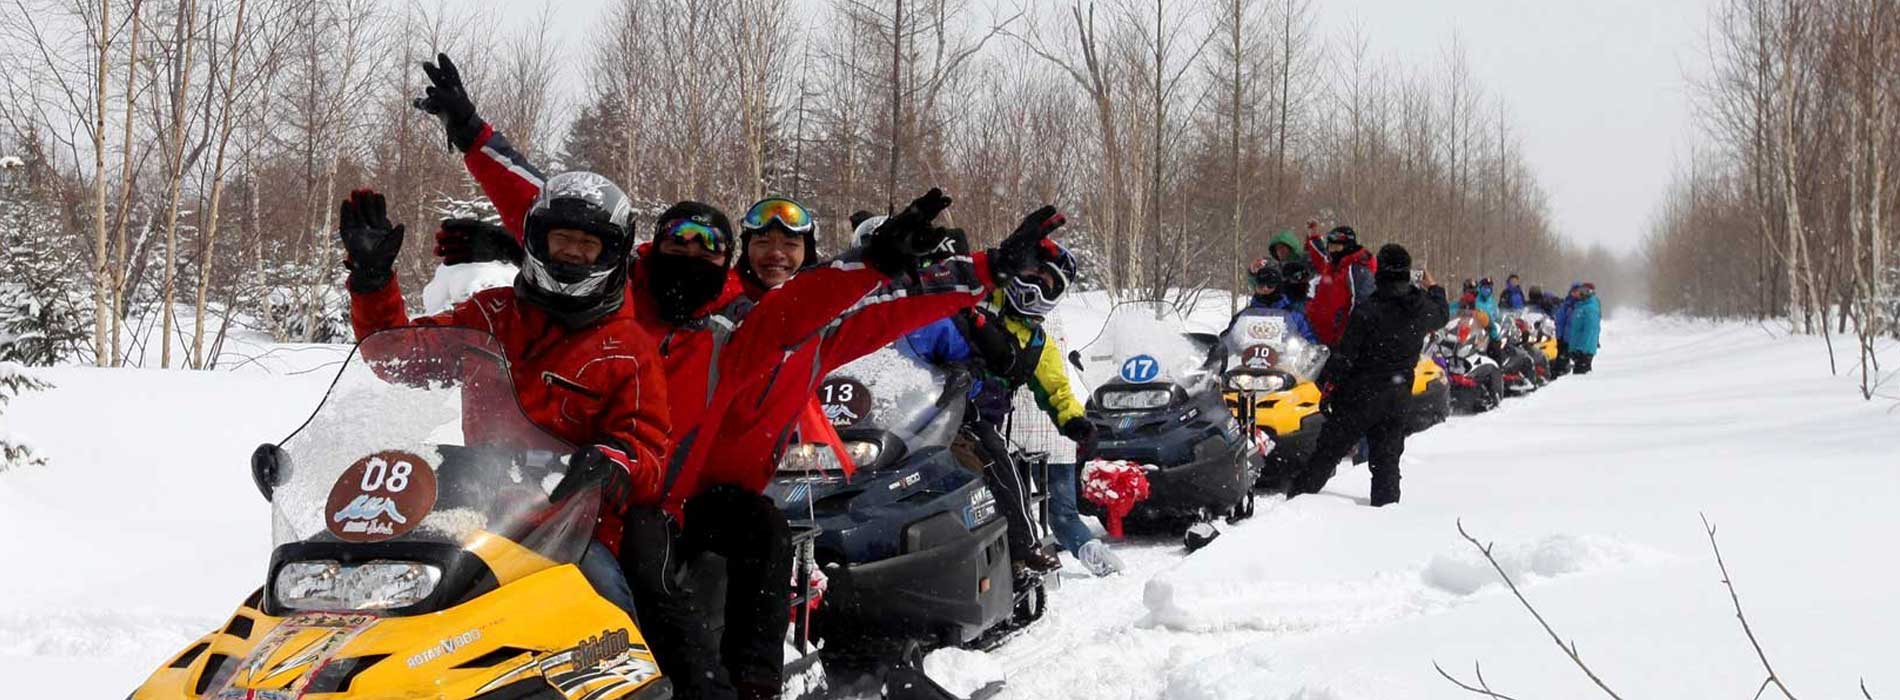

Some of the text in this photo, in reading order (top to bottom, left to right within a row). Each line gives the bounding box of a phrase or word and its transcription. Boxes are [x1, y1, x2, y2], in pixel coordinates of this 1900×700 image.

[1254, 347, 1269, 357] 10
[1125, 360, 1153, 379] 17
[824, 384, 853, 403] 13
[361, 457, 413, 492] 08
